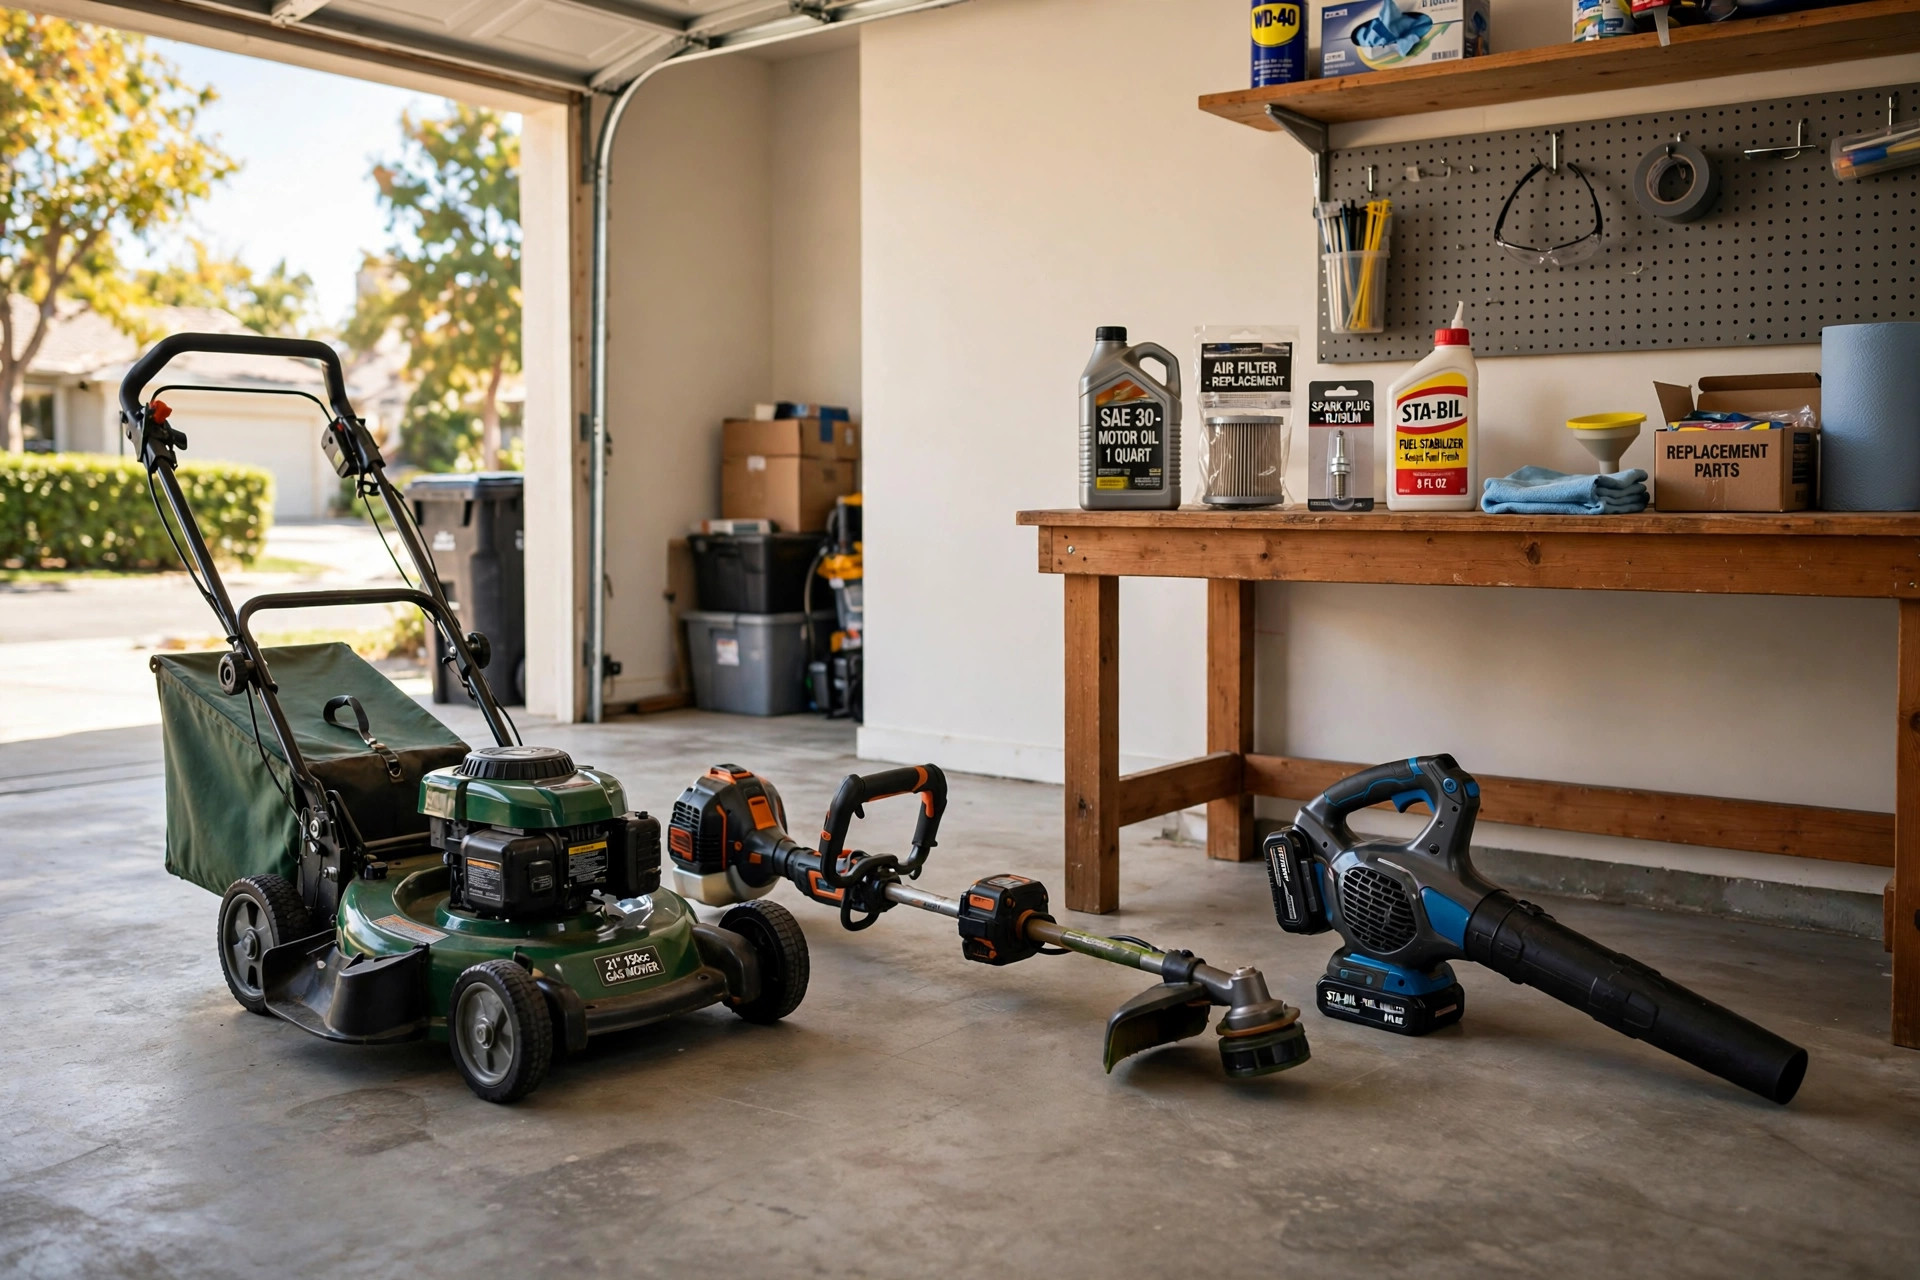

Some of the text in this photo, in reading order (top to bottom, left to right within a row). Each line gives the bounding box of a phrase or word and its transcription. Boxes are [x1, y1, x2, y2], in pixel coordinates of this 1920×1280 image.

[1213, 361, 1277, 374] AIR FILTER
[1211, 375, 1285, 387] REPLACEMENT
[1311, 400, 1371, 412] SPARK PLUG
[1402, 399, 1463, 422] STA-BIL
[1100, 408, 1131, 427] SAE
[1098, 430, 1159, 445] MOTOR OIL
[1399, 438, 1418, 450] FUEL
[1106, 448, 1152, 464] 1 QUART
[1666, 443, 1769, 460] REPLACEMENT
[1694, 462, 1740, 478] PARTS
[1424, 478, 1434, 489] FL
[1435, 478, 1447, 489] OZ
[605, 968, 626, 982] GAS
